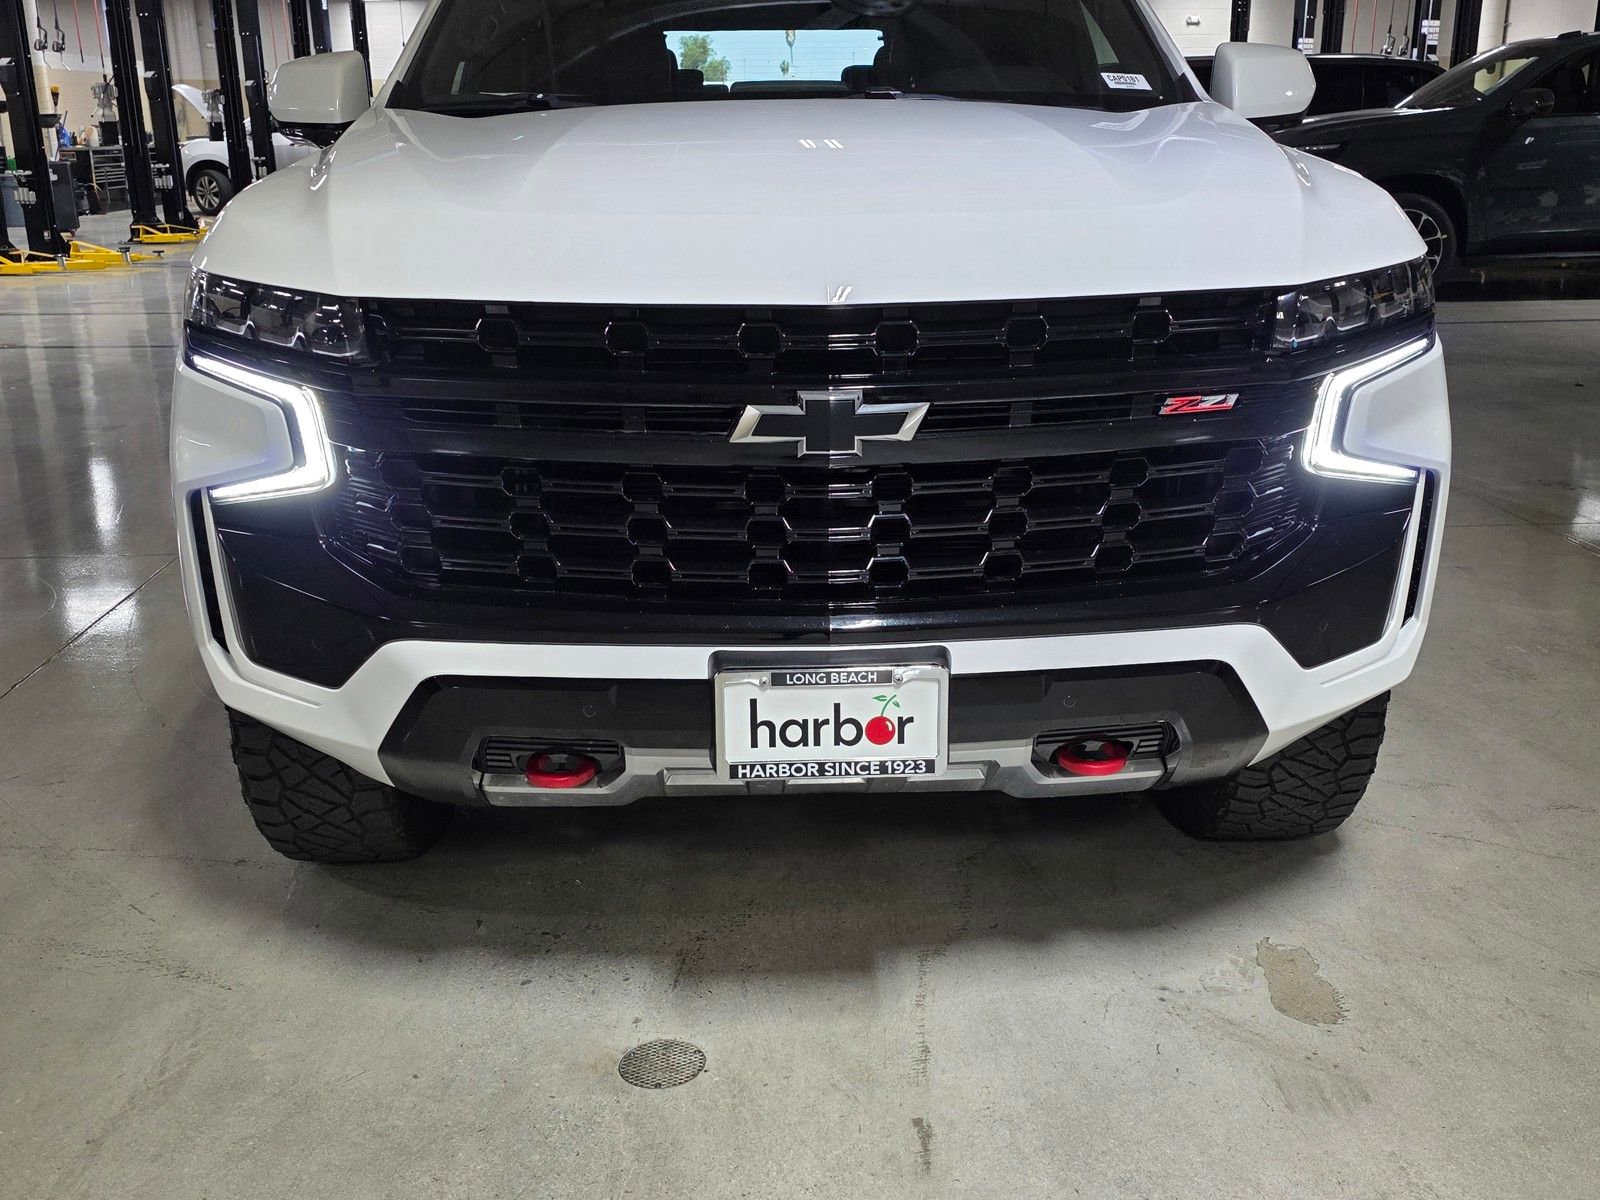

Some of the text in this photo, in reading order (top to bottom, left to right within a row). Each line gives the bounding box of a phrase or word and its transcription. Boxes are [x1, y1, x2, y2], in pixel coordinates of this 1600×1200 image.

[786, 671, 878, 685] LONG BEACH
[749, 697, 915, 749] harbor
[737, 760, 926, 779] HARBOR SINCE 1923
